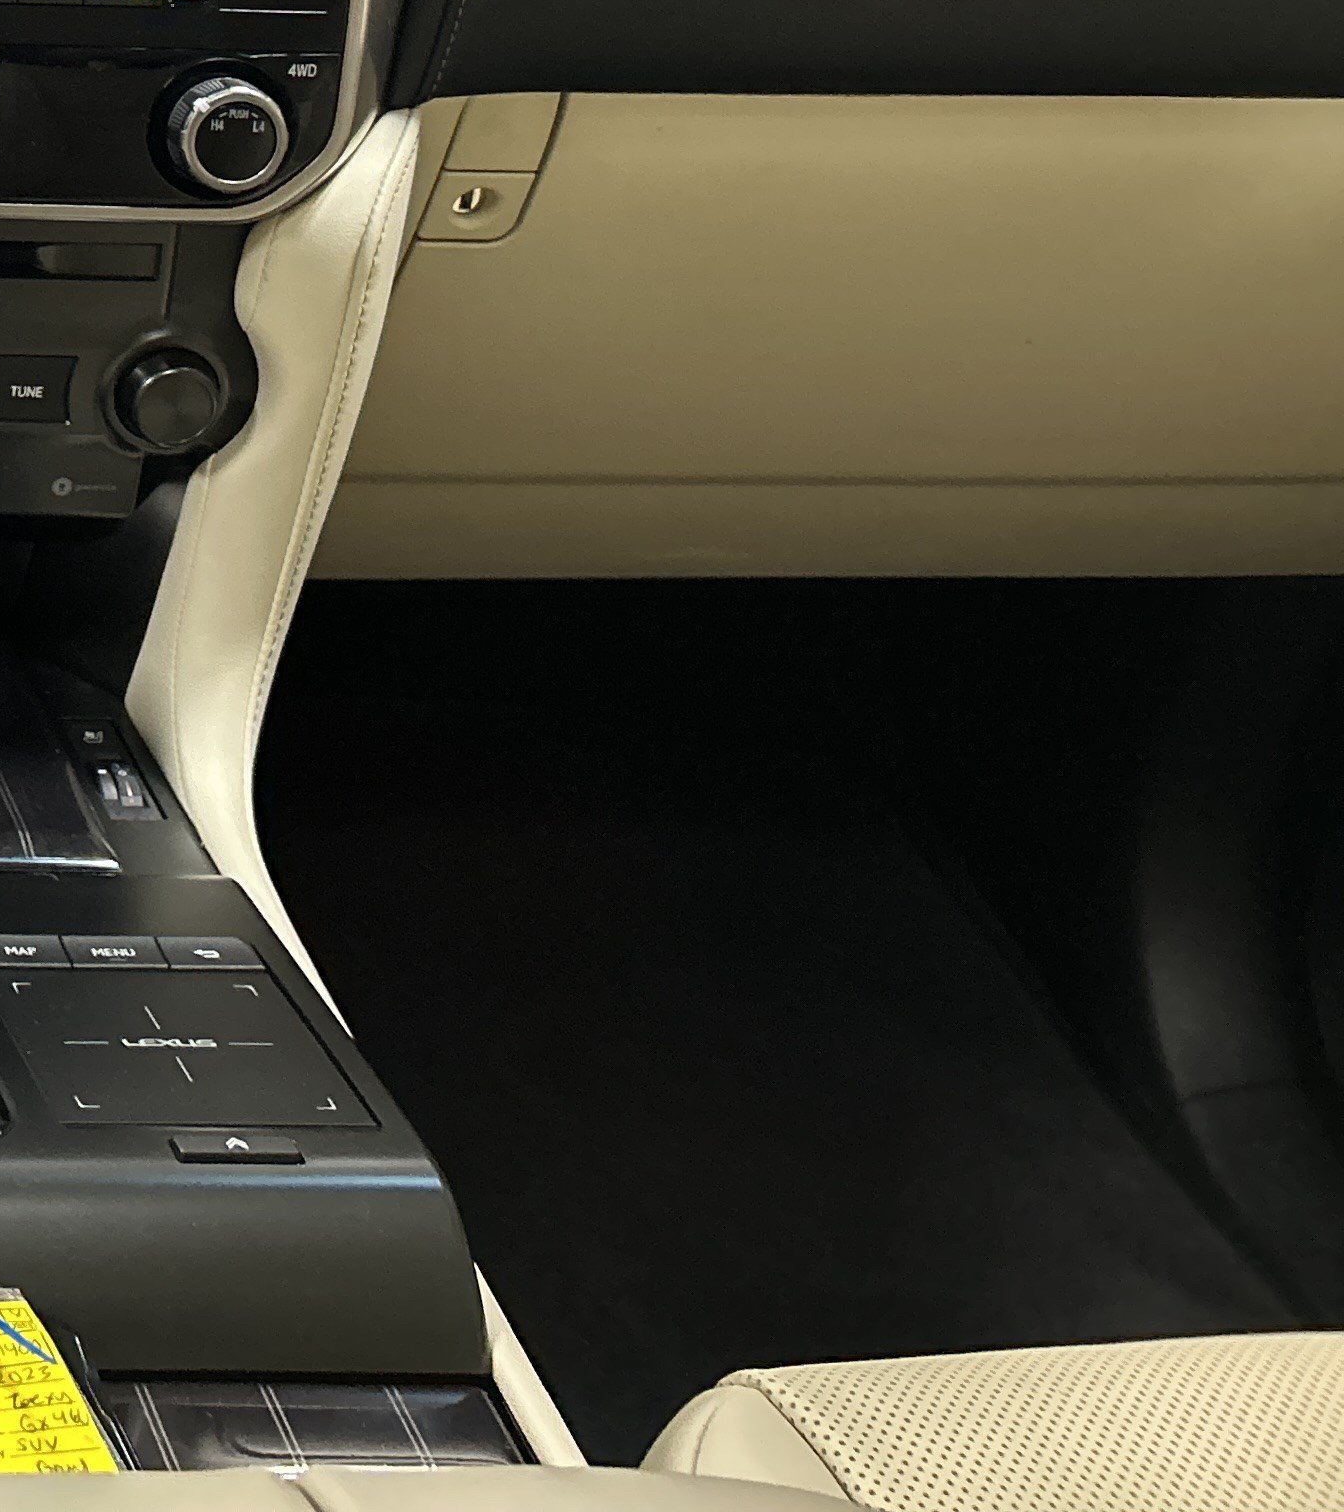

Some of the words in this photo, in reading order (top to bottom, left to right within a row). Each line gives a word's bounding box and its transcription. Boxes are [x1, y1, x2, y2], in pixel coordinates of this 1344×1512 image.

[288, 63, 318, 79] 4WD
[210, 118, 226, 132] H4
[252, 119, 266, 134] L4
[10, 384, 45, 400] TUNE
[3, 944, 37, 958] MAP
[90, 946, 137, 959] MENU
[121, 1037, 218, 1049] LEXUS
[15, 1435, 59, 1454] SUV
